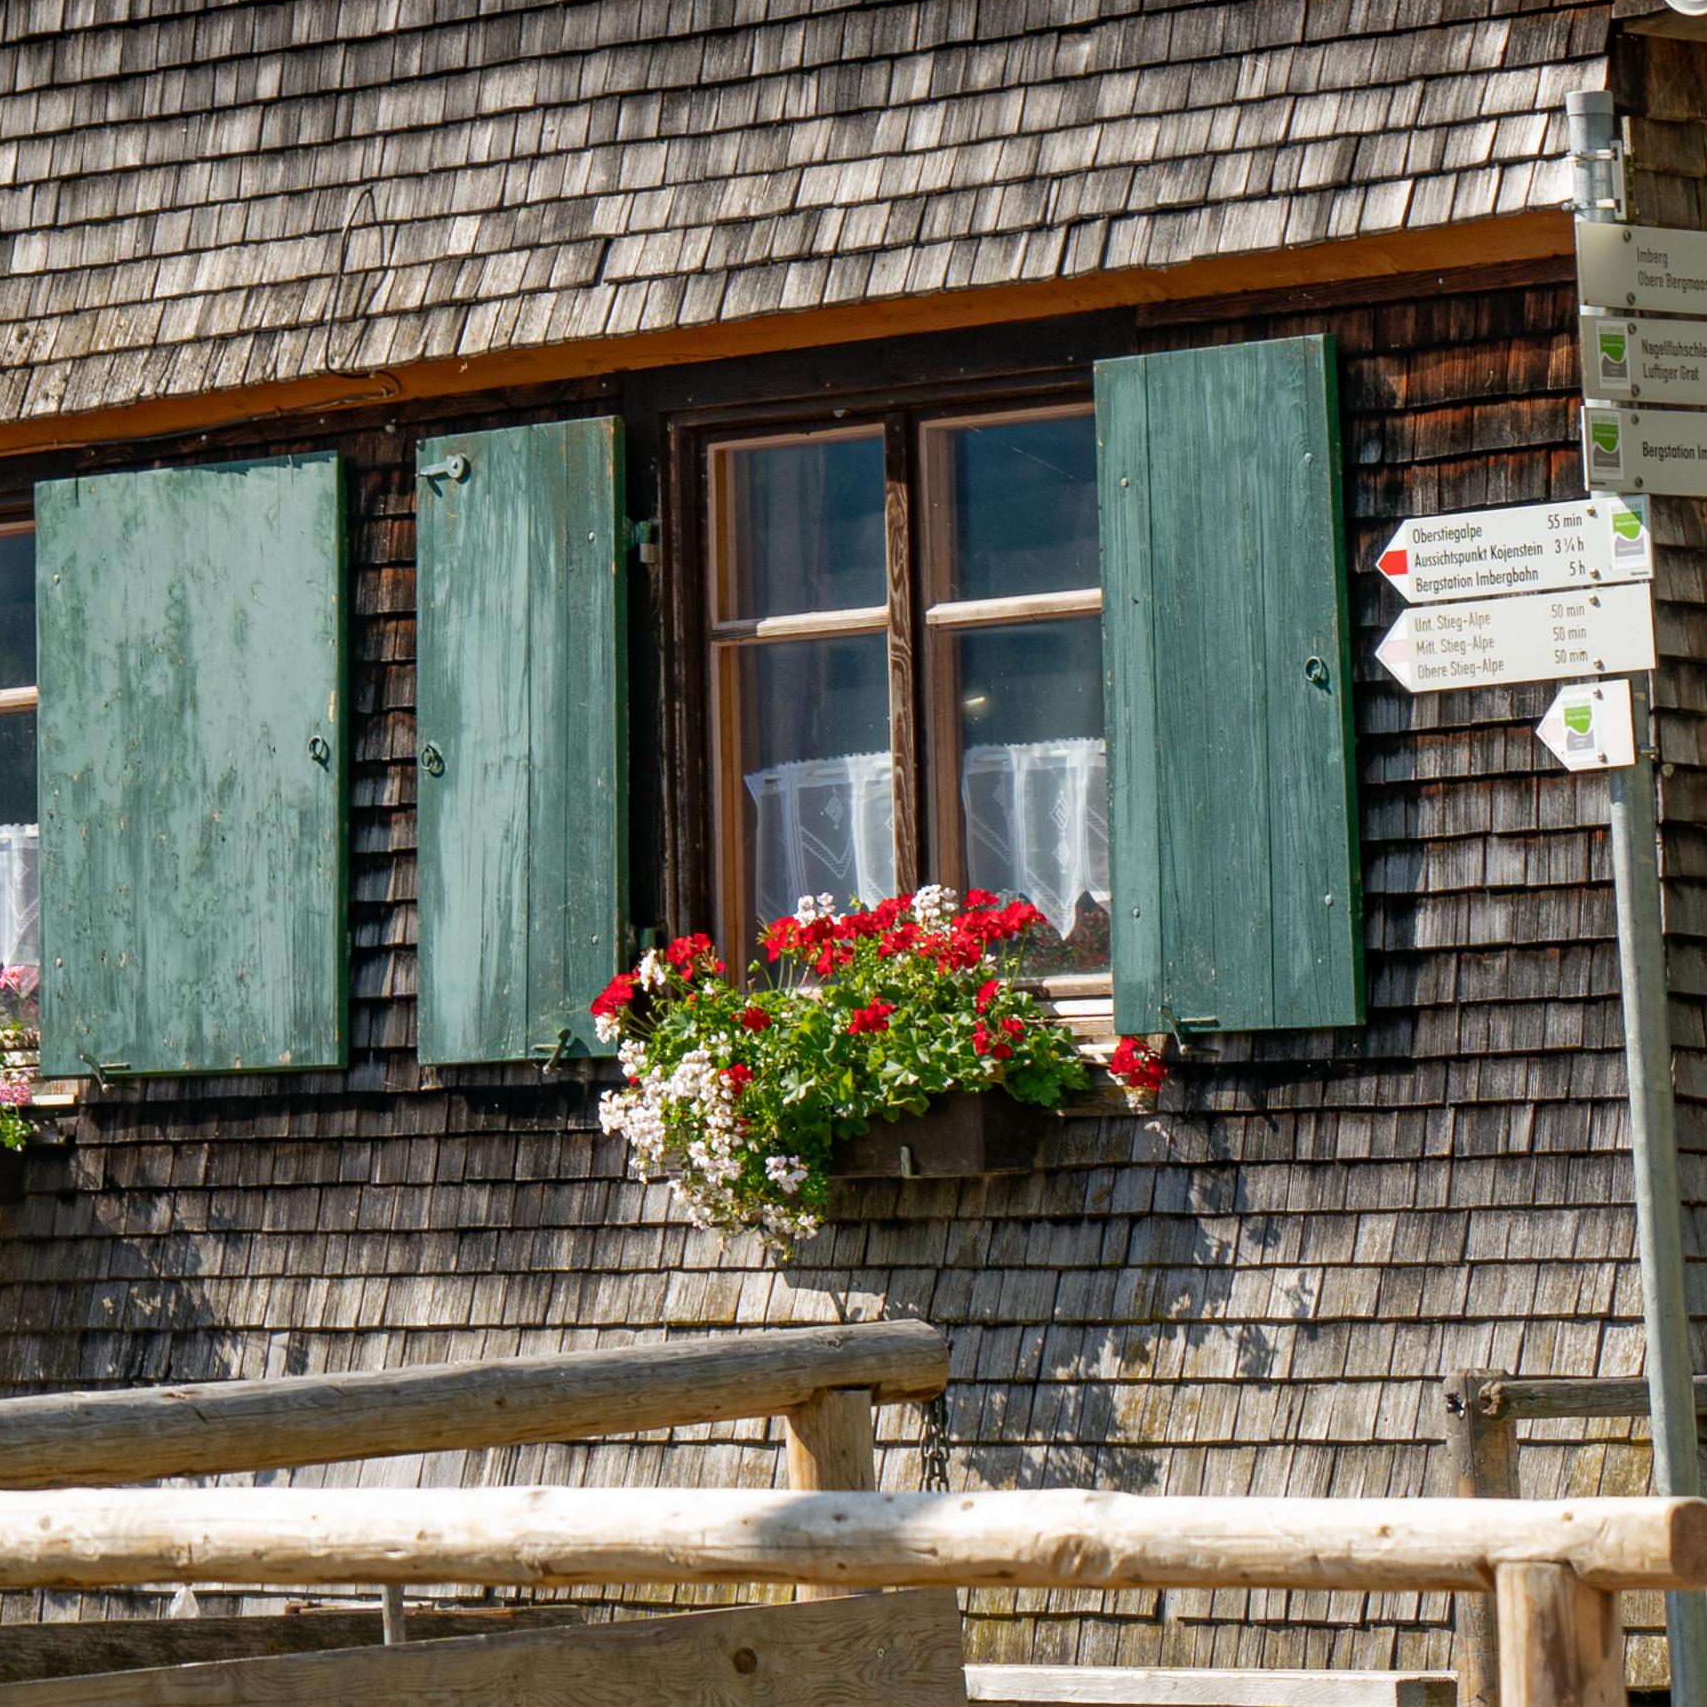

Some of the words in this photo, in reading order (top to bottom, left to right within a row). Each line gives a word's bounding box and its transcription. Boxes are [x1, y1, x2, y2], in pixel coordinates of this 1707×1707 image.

[1637, 246, 1668, 268] Imberg
[1638, 271, 1664, 288] Obere
[1643, 363, 1678, 383] Luftiger
[1680, 365, 1700, 382] Grat
[1642, 441, 1695, 462] Bergstation
[1412, 523, 1483, 544] Oberstiegalpe
[1547, 515, 1560, 530] 55
[1563, 514, 1583, 528] min
[1414, 545, 1487, 568] Aussichtspunkt
[1490, 542, 1544, 563] Kojenstein
[1555, 539, 1562, 554] 3
[1577, 537, 1584, 552] h
[1416, 573, 1474, 594] Bergstation
[1476, 568, 1539, 590] Imbergbahn
[1569, 563, 1576, 576] 5
[1578, 561, 1586, 575] h
[1437, 611, 1491, 632] Stieg-Alpe
[1551, 604, 1563, 618] 50
[1566, 602, 1585, 617] min
[1441, 635, 1495, 656] Stieg-Alpe
[1553, 627, 1565, 641] 50
[1568, 625, 1587, 640] min
[1418, 663, 1447, 680] Obere
[1450, 658, 1504, 679] Stieg-Alpe
[1554, 650, 1567, 664] 50
[1569, 648, 1588, 663] min
